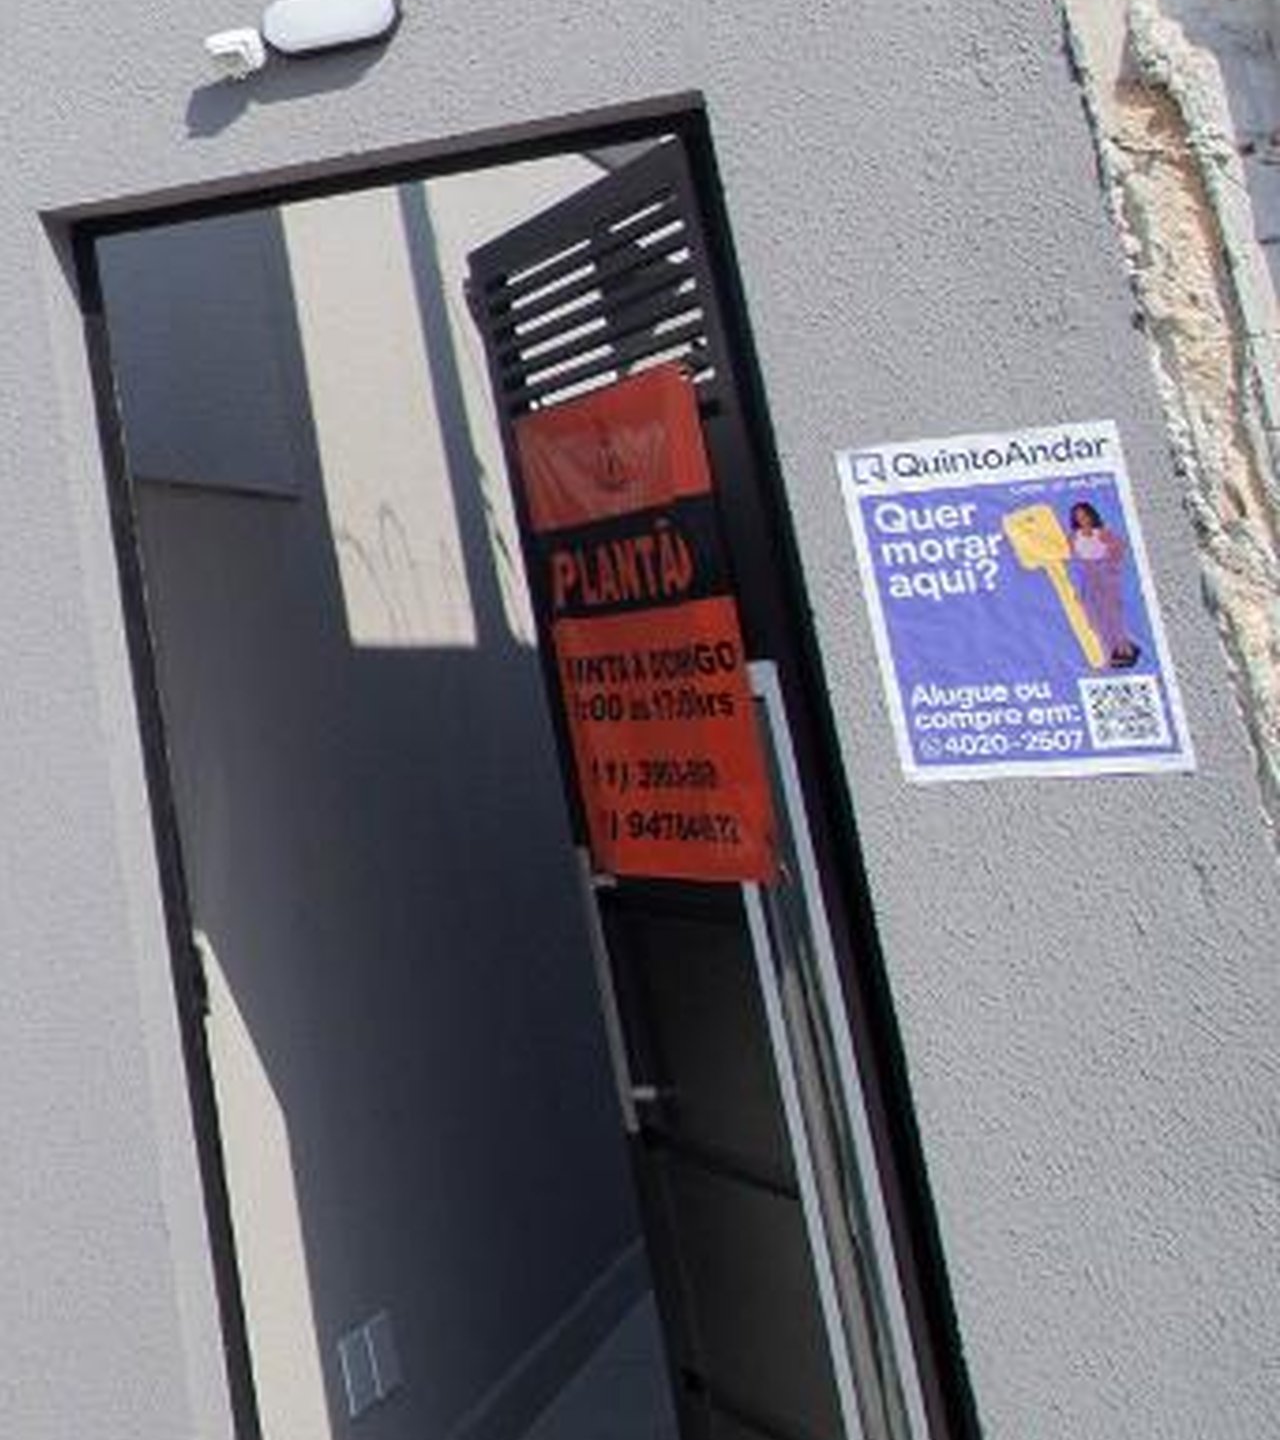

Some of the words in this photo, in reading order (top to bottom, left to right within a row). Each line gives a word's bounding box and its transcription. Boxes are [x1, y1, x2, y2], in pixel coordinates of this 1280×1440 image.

[891, 434, 1109, 480] QuintoAndar
[873, 500, 978, 534] Quer
[880, 531, 1003, 567] morar
[888, 560, 1000, 600] aqui?
[911, 683, 1010, 710] Alugue
[1014, 681, 1052, 702] ou
[915, 707, 1023, 731] compre
[1027, 703, 1082, 726] em:
